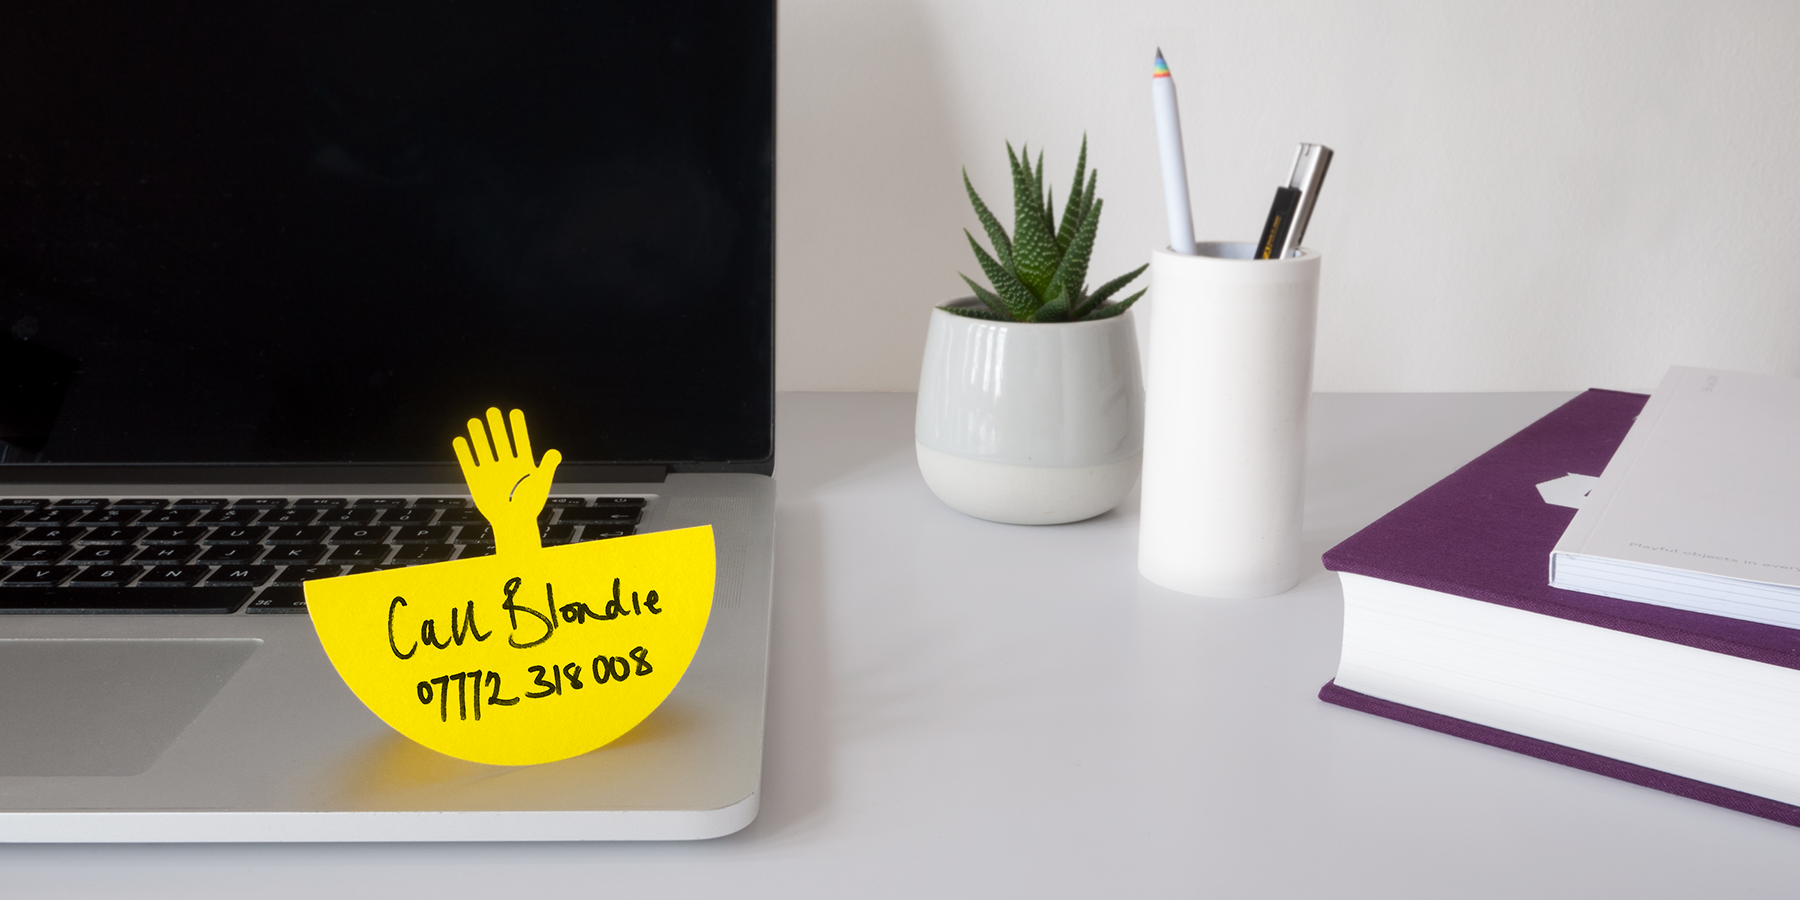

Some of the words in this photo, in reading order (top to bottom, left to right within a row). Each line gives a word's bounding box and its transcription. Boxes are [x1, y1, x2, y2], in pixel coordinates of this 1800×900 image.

[1629, 541, 1678, 554] Playful
[1682, 551, 1738, 563] objects
[388, 597, 492, 659] Call
[502, 577, 662, 649] Blondie
[417, 670, 519, 722] 07772
[526, 663, 583, 698] 318
[593, 647, 652, 684] 008
